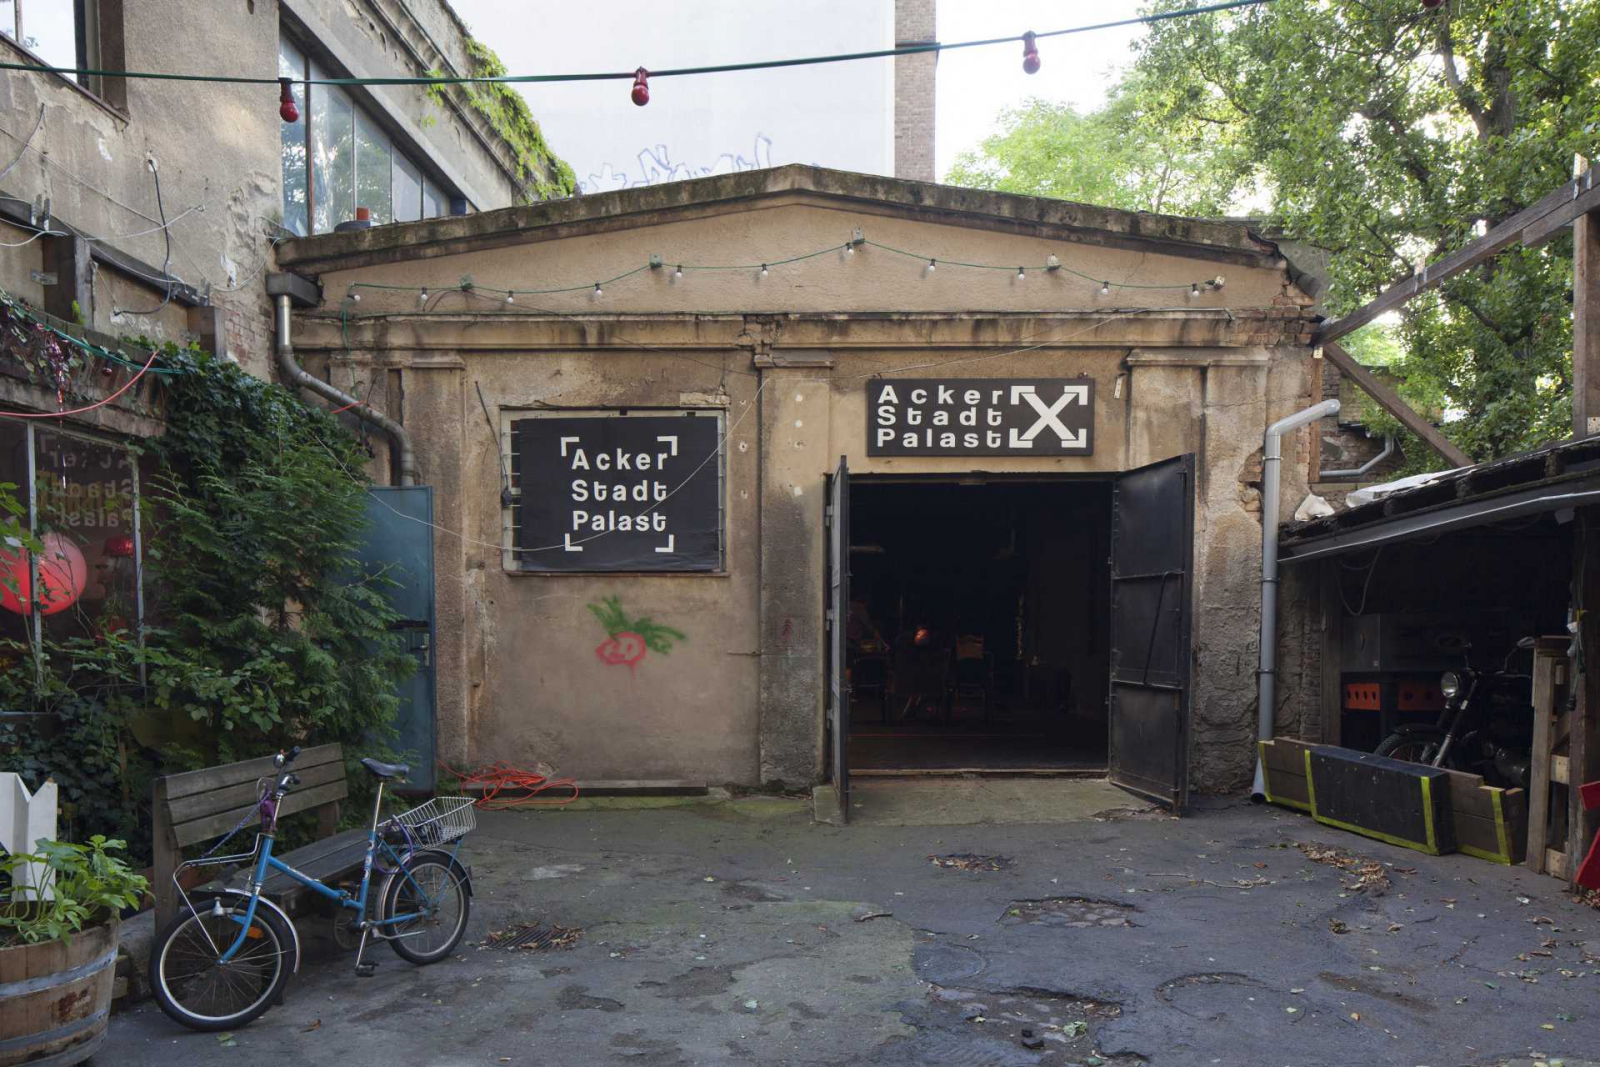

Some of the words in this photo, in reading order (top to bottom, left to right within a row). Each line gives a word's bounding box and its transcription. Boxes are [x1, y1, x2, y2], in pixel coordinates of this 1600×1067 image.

[877, 384, 1003, 405] Acker
[877, 405, 1002, 427] Stadt
[877, 428, 1002, 448] Palast
[571, 448, 668, 470] Acker
[571, 479, 668, 502] Stadt
[572, 510, 667, 532] Palast
